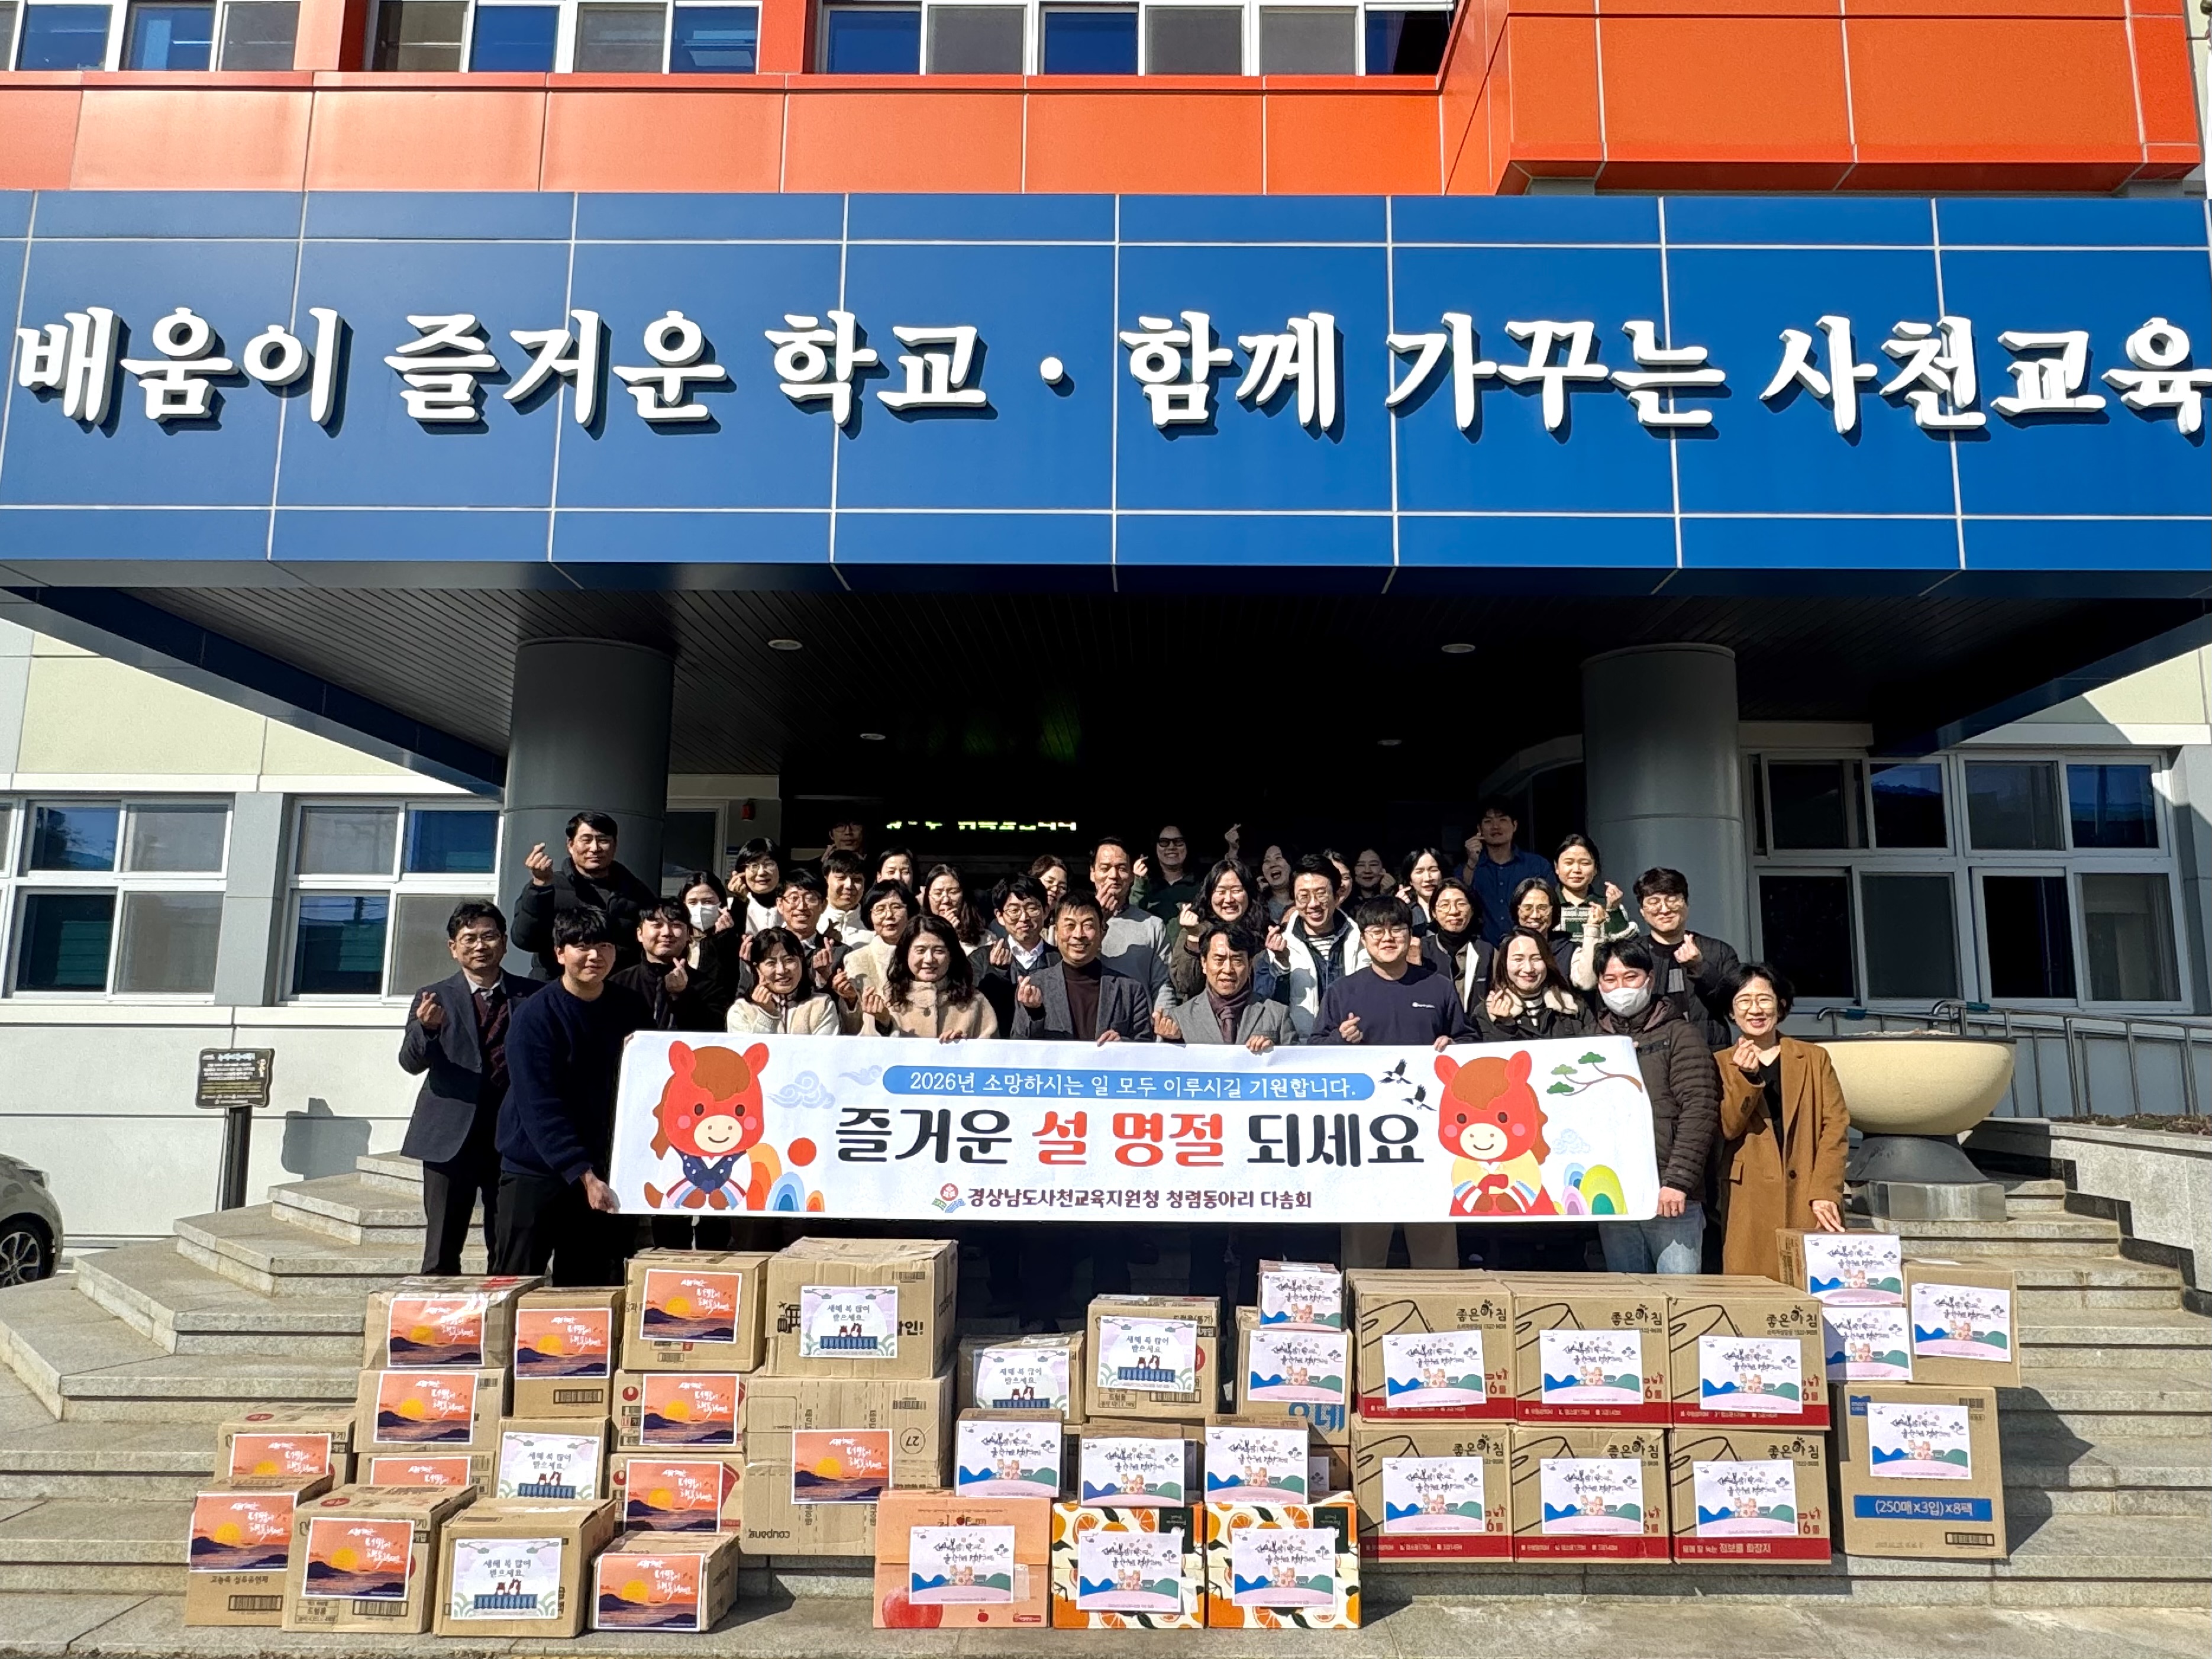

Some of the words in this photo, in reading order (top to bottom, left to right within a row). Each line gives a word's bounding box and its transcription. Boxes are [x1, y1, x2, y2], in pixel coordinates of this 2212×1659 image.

[17, 306, 343, 424] 배움이
[384, 311, 725, 426] 즐거운
[764, 310, 987, 426] 학교
[1119, 312, 1336, 430] 함께
[1386, 314, 1725, 432] 가꾸는
[1760, 317, 2212, 435] 사천교육
[910, 1071, 974, 1094] 2026년
[982, 1073, 1084, 1096] 소망하시는
[1090, 1075, 1109, 1098] 일
[1119, 1076, 1157, 1098] 모두
[1164, 1077, 1241, 1099] 이루시길
[1249, 1078, 1356, 1100] 기원합니다.
[835, 1108, 1012, 1164] 즐거운
[1032, 1111, 1087, 1165] 설
[1113, 1113, 1224, 1167] 명절
[1247, 1113, 1425, 1167] 되세요
[968, 1188, 1160, 1209] 경상남도사천교육지원청
[1167, 1190, 1254, 1209] 청렴동아리
[1260, 1191, 1312, 1210] 다솜회
[897, 1321, 923, 1336] 인!
[906, 1436, 919, 1447] 27
[748, 1528, 790, 1539] coupang
